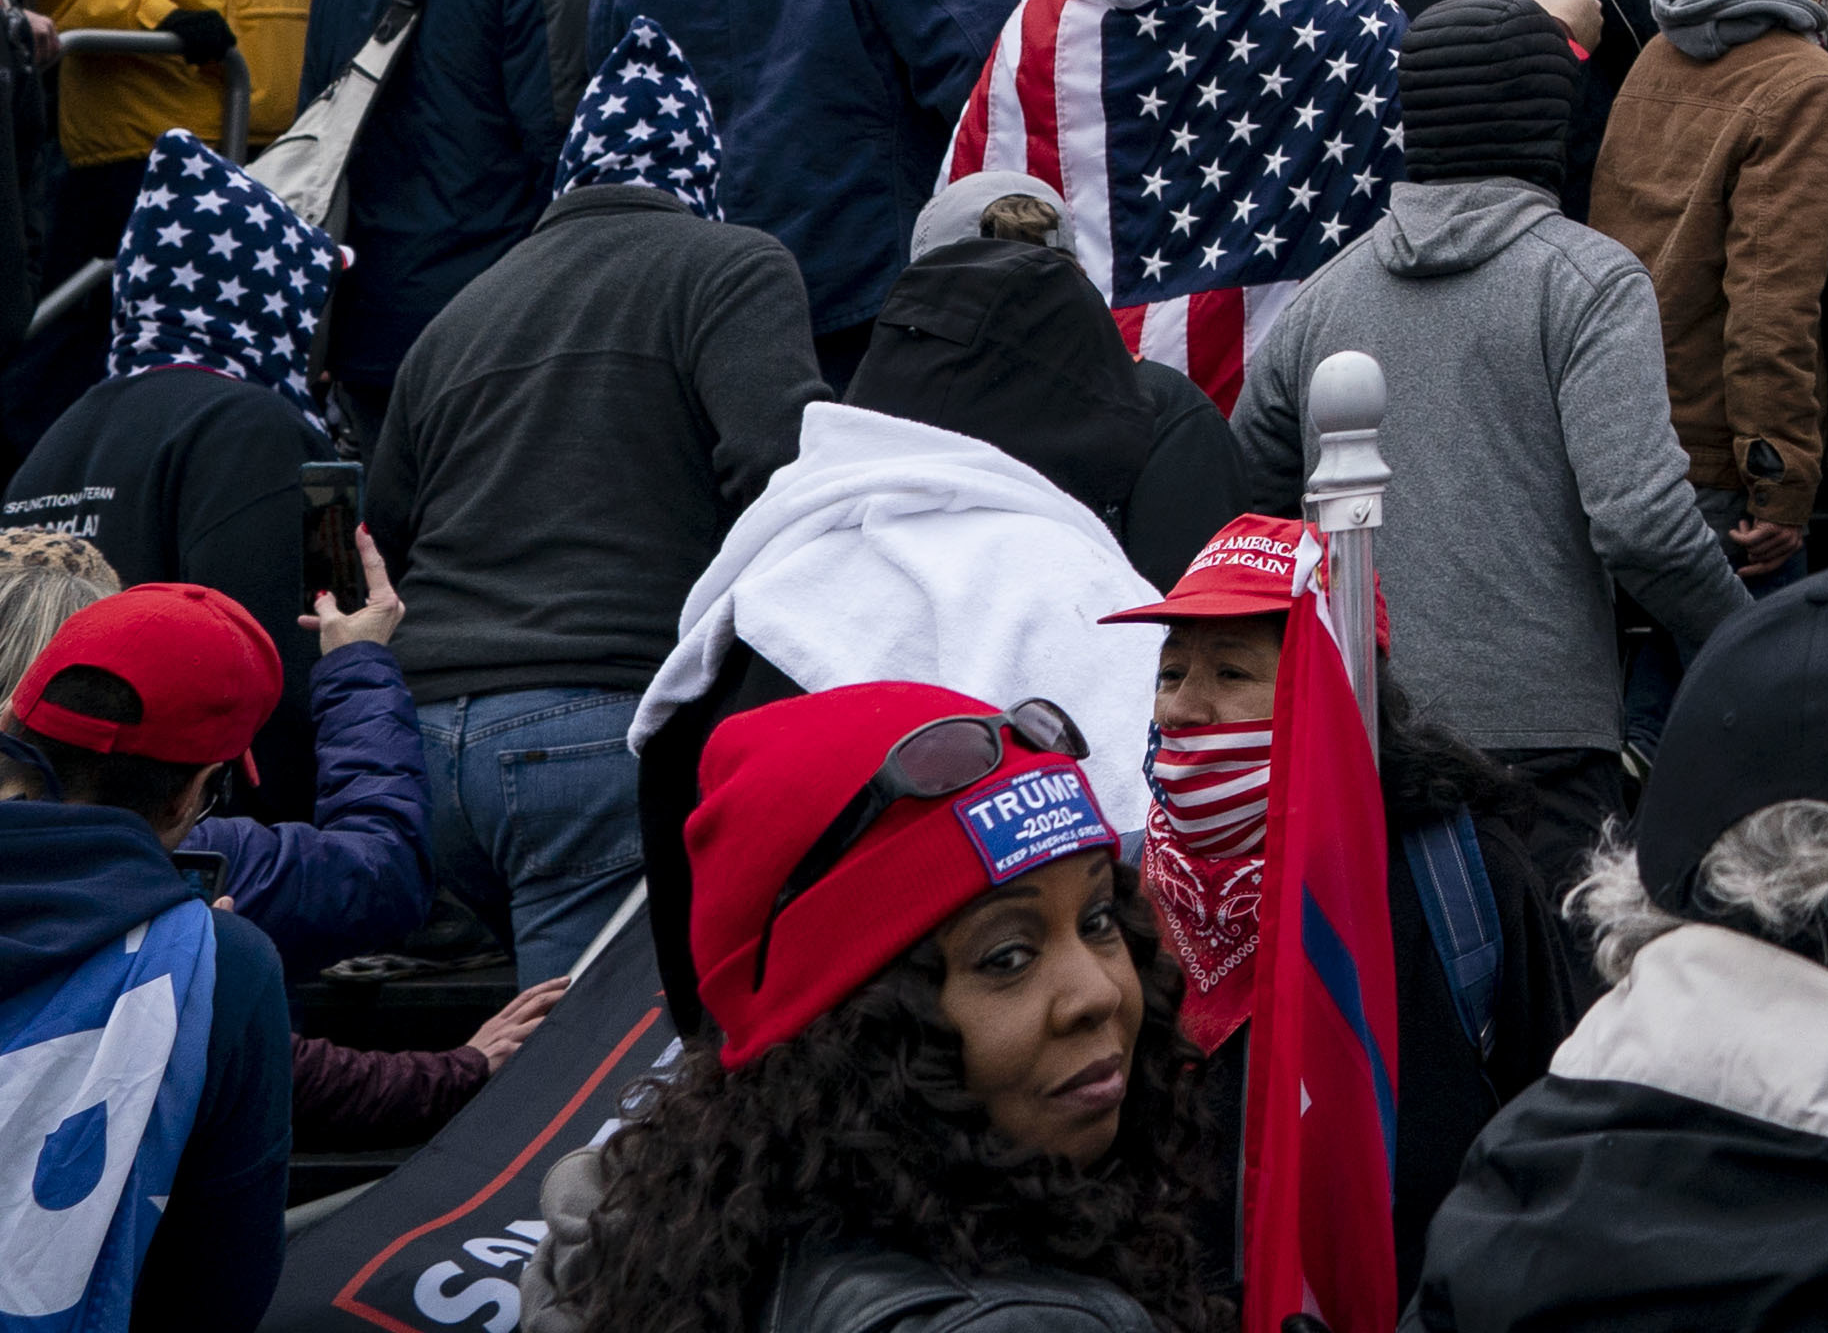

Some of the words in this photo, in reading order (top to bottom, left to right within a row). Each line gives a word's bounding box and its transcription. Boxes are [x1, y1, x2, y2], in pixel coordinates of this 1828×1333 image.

[1225, 552, 1291, 576] AGAIN
[968, 773, 1081, 830] TRUMP
[996, 847, 1029, 873] KEEP
